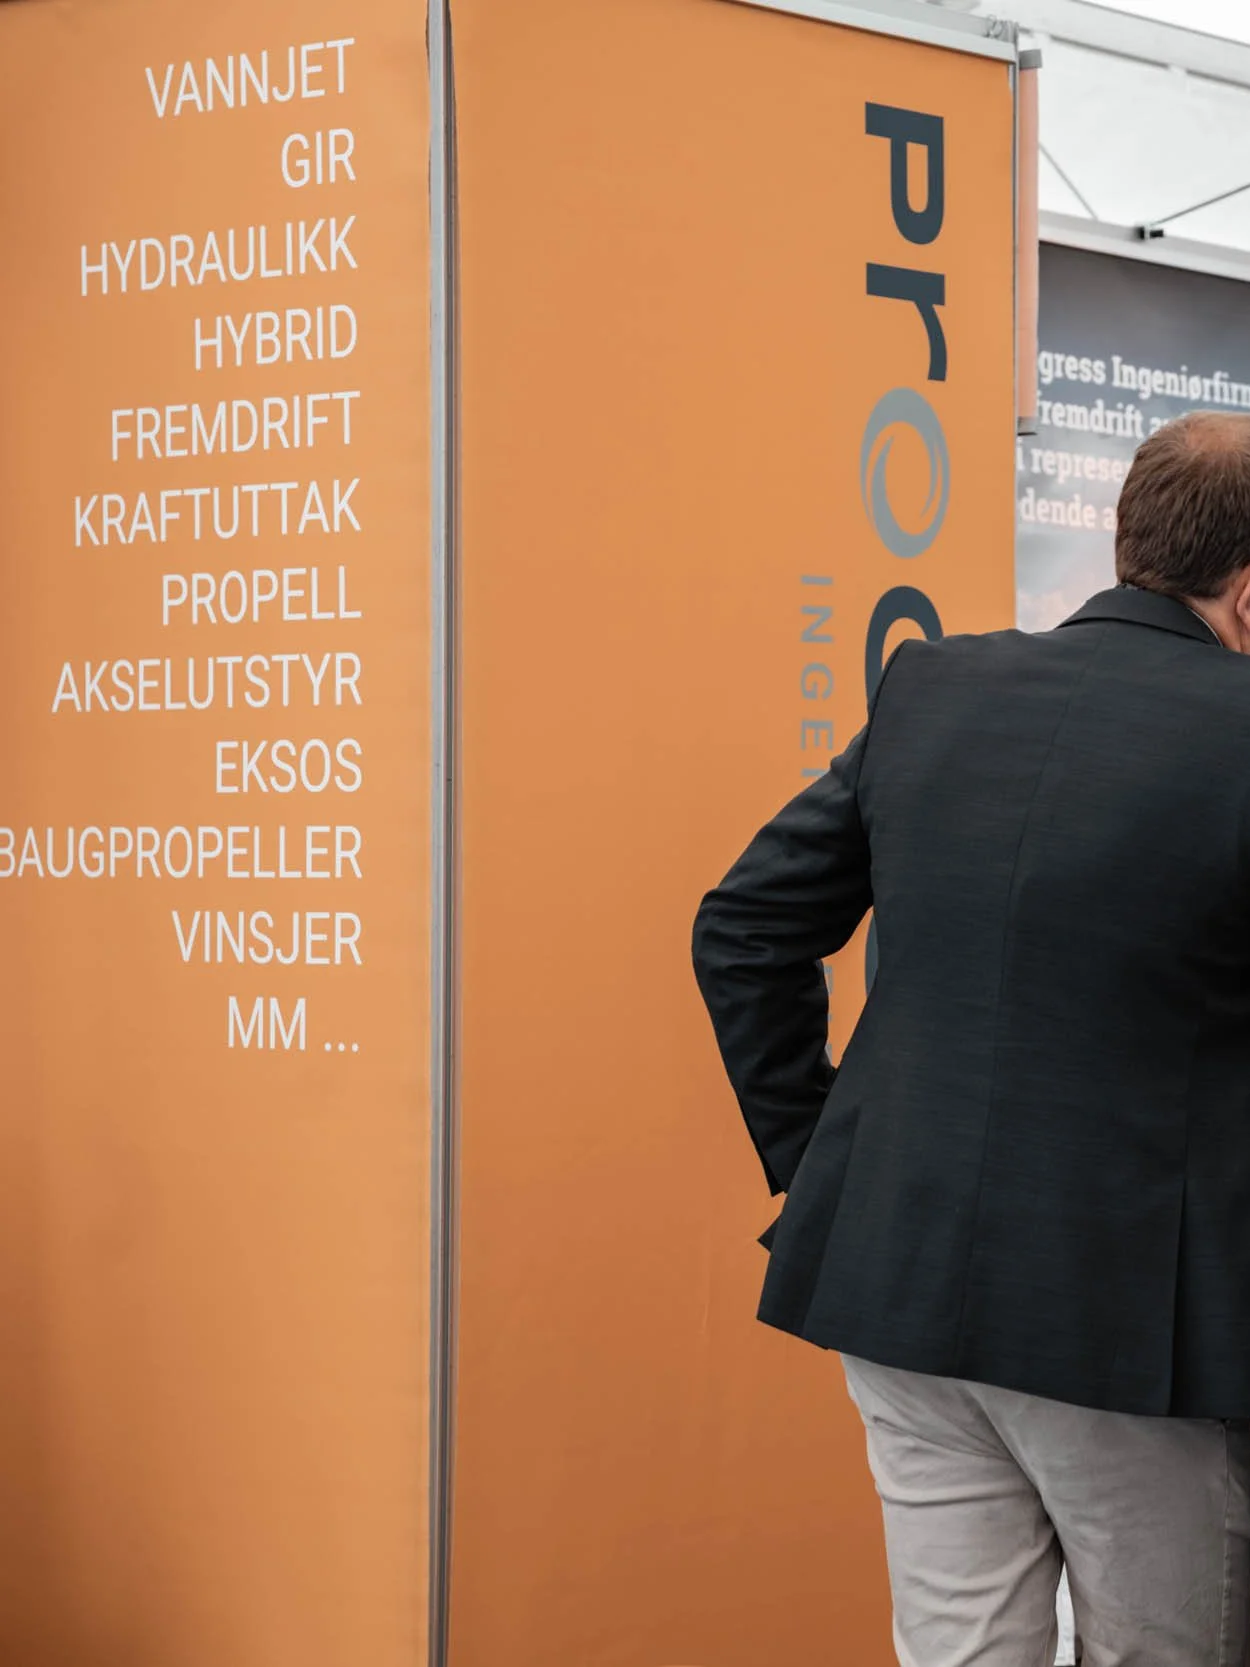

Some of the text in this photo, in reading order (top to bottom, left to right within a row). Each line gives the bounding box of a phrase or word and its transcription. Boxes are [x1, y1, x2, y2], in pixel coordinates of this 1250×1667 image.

[145, 37, 356, 118] VANNJET
[281, 127, 357, 189] GIR
[80, 215, 358, 297] HYDRAULIKK
[194, 304, 358, 370] HYBRID
[111, 390, 361, 461] FREMDRIFT
[75, 477, 362, 547] KRAFTUTTAK
[162, 565, 363, 626] PROPELL
[51, 651, 363, 713] AKSELUTSTYR
[215, 737, 363, 794] EKSOS
[0, 825, 363, 879] BAUGPROPELLER
[171, 910, 363, 965] VINSJER
[228, 995, 307, 1051] MM
